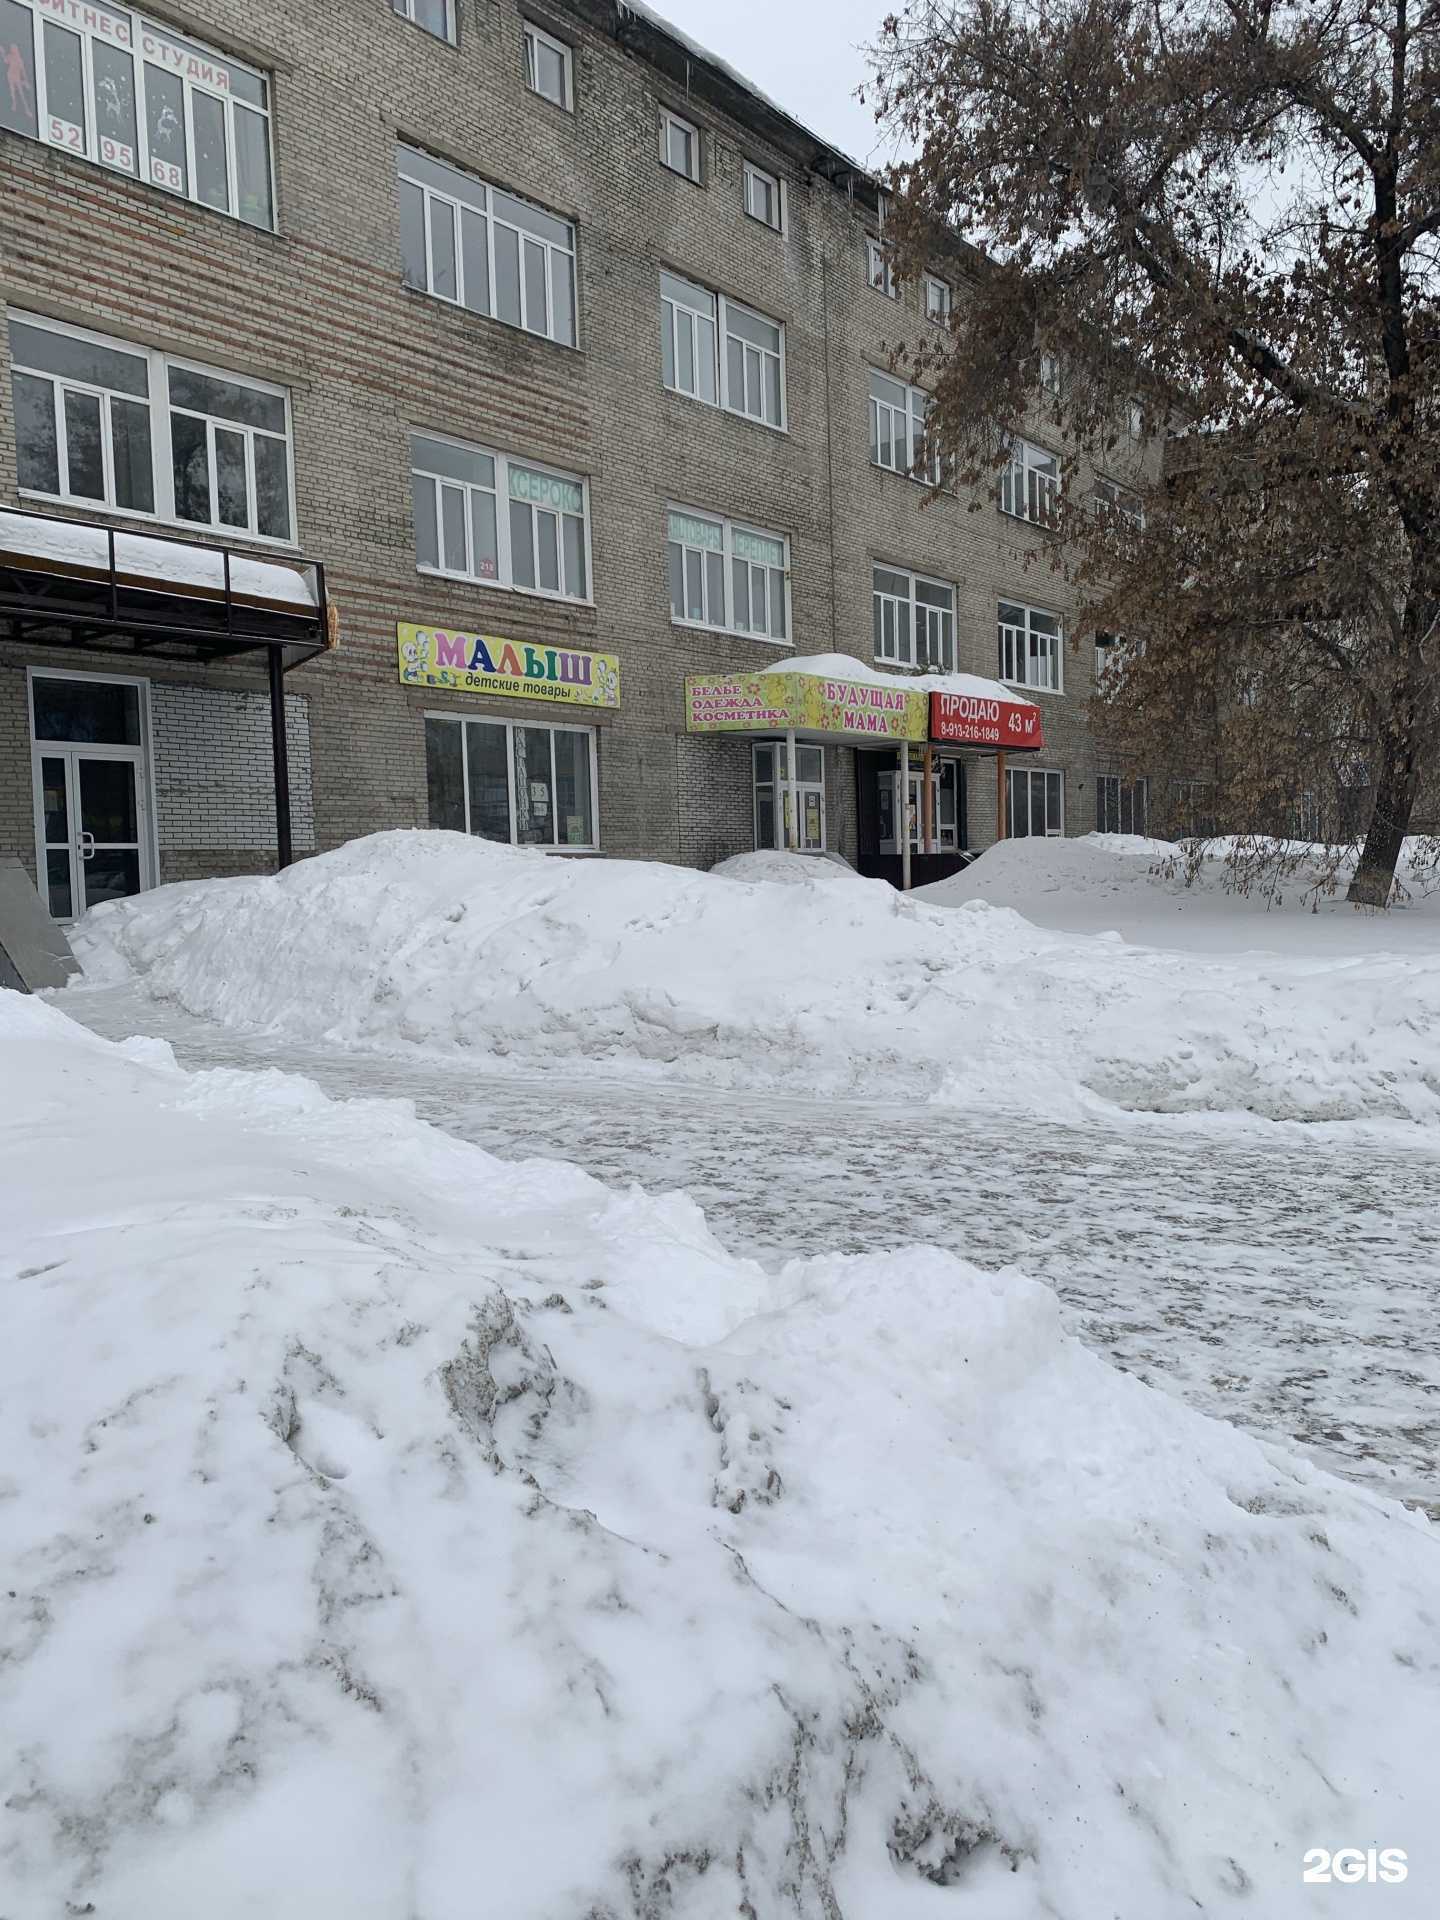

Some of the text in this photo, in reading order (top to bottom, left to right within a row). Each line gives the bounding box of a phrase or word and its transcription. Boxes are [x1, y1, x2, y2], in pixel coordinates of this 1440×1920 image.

[142, 37, 230, 89] СТУДИЯ
[50, 119, 181, 187] 52 95 68
[434, 633, 592, 685] МАЛЫШ
[465, 672, 571, 699] детские товары
[826, 682, 905, 710] БУДУЩАЯ
[692, 696, 763, 709] ОДЕЖДА
[692, 709, 789, 722] КОСМЕТИКА
[940, 695, 999, 722] ПРОДАЮ
[843, 710, 889, 733] МАМА
[940, 724, 999, 742] 8-913-216-1849
[1008, 712, 1022, 733] 43
